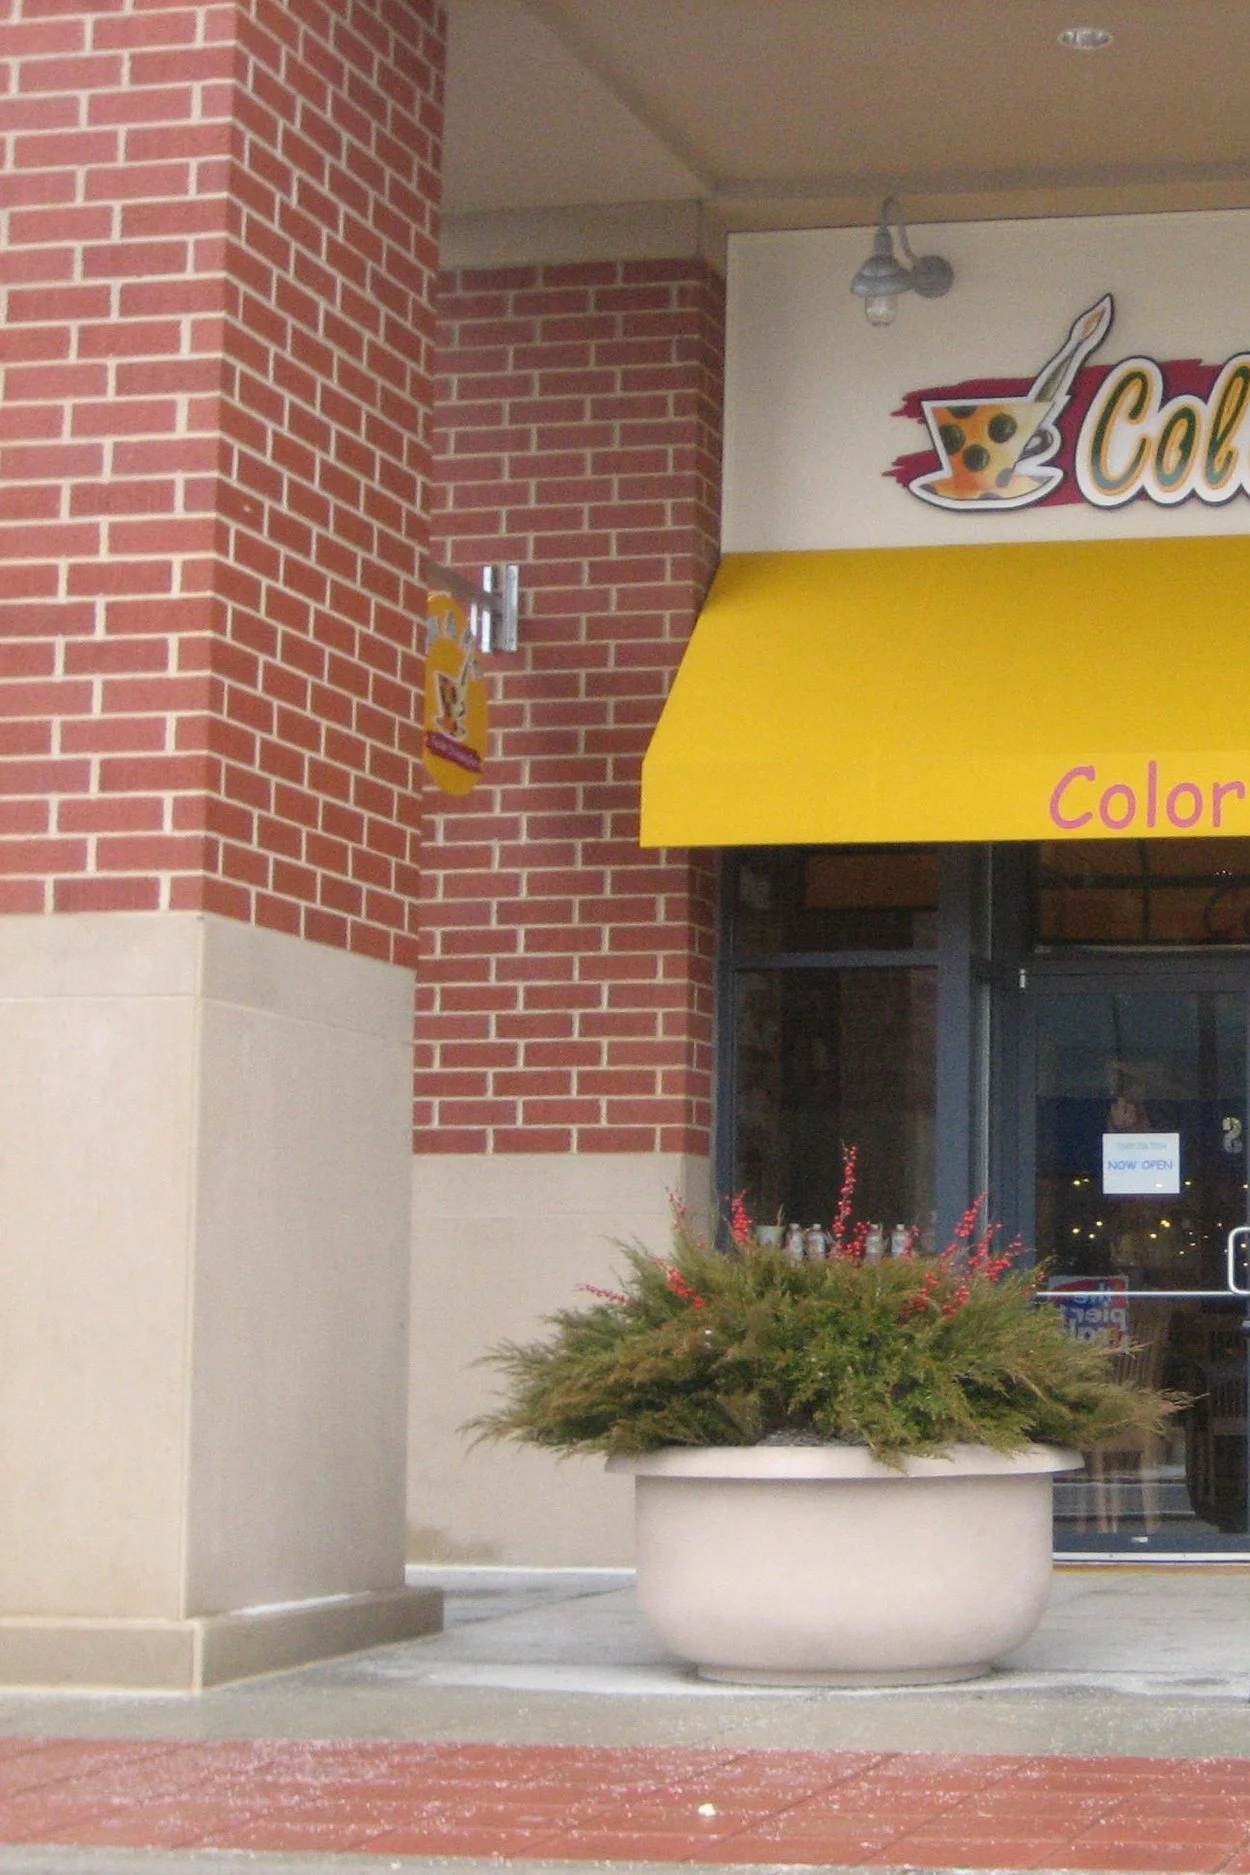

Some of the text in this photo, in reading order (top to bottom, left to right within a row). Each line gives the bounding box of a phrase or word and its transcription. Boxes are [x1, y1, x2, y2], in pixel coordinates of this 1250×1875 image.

[1049, 759, 1246, 830] Color
[1107, 1159, 1173, 1170] NOW OPEN
